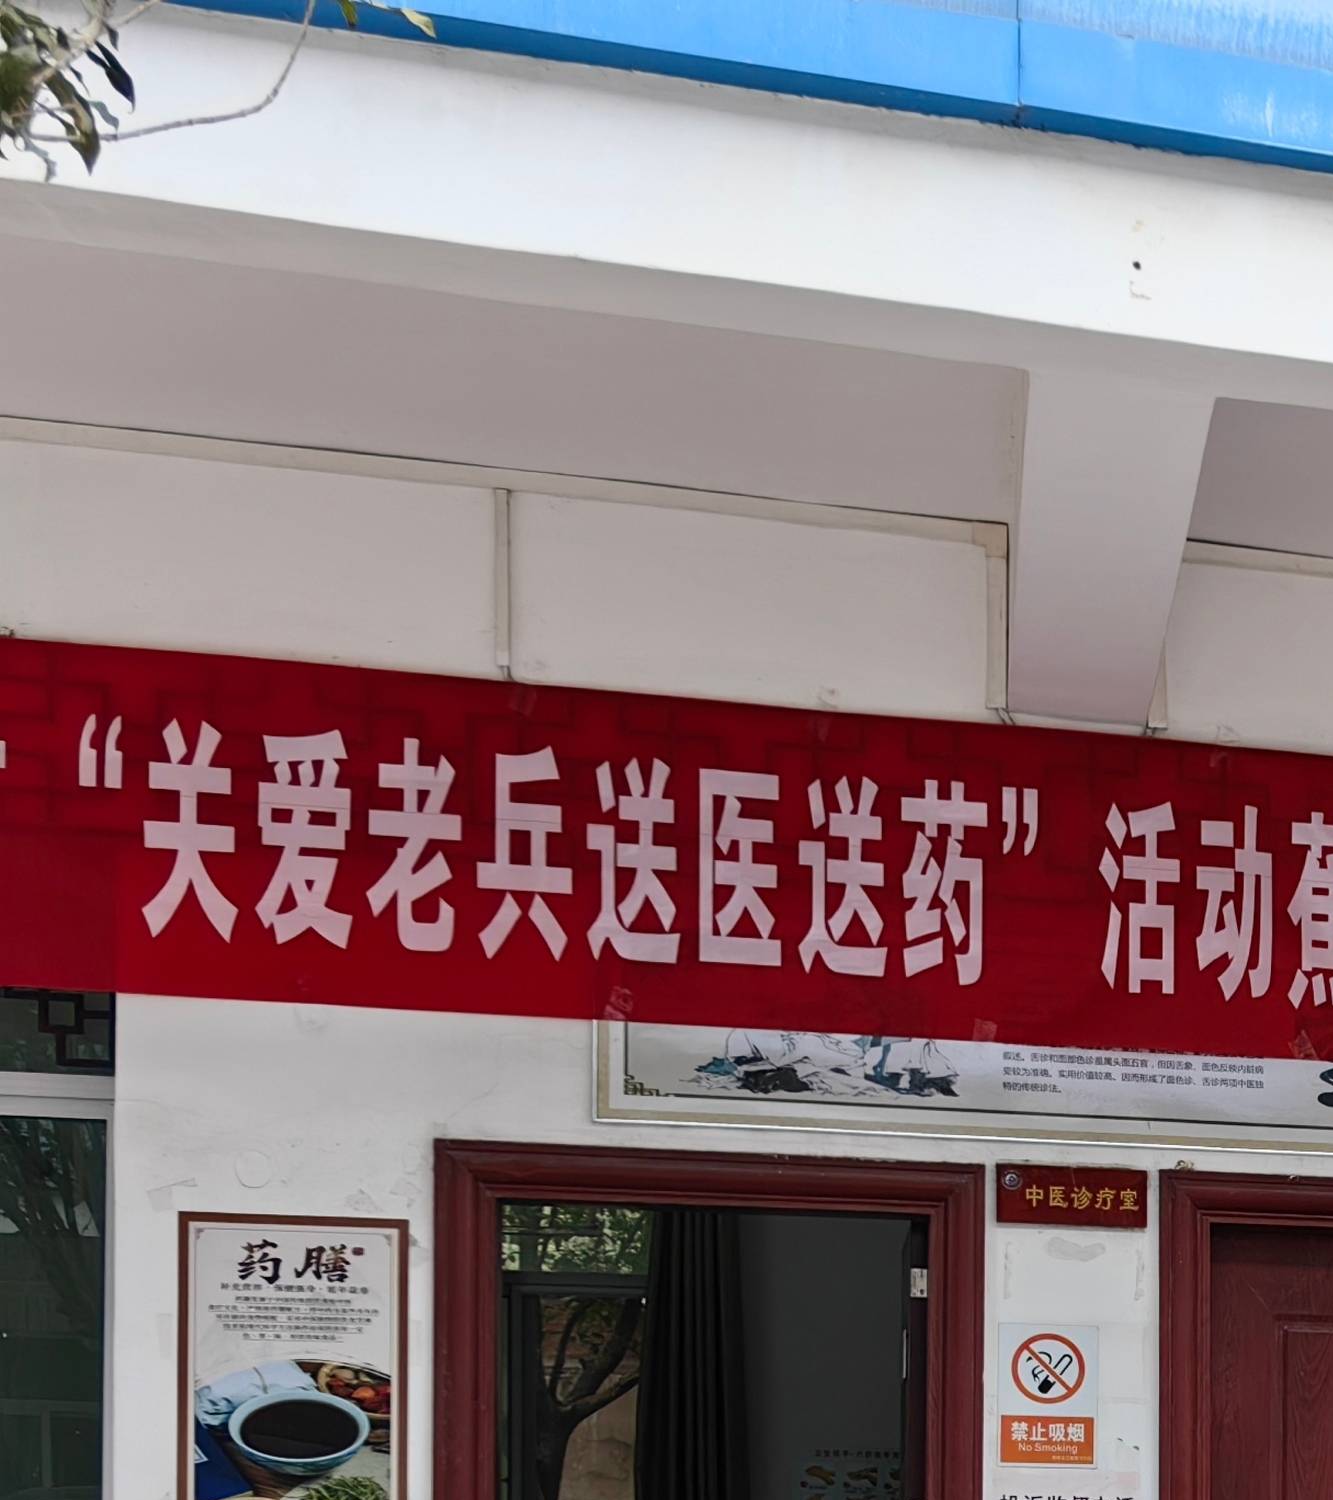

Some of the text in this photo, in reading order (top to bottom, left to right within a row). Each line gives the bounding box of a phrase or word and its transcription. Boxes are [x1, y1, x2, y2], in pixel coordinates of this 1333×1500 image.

[1025, 1184, 1140, 1212] 中医诊疗室
[237, 1239, 352, 1284] 药膳
[1011, 1420, 1084, 1442] 禁止吸烟
[1018, 1442, 1078, 1454] No Smoking
